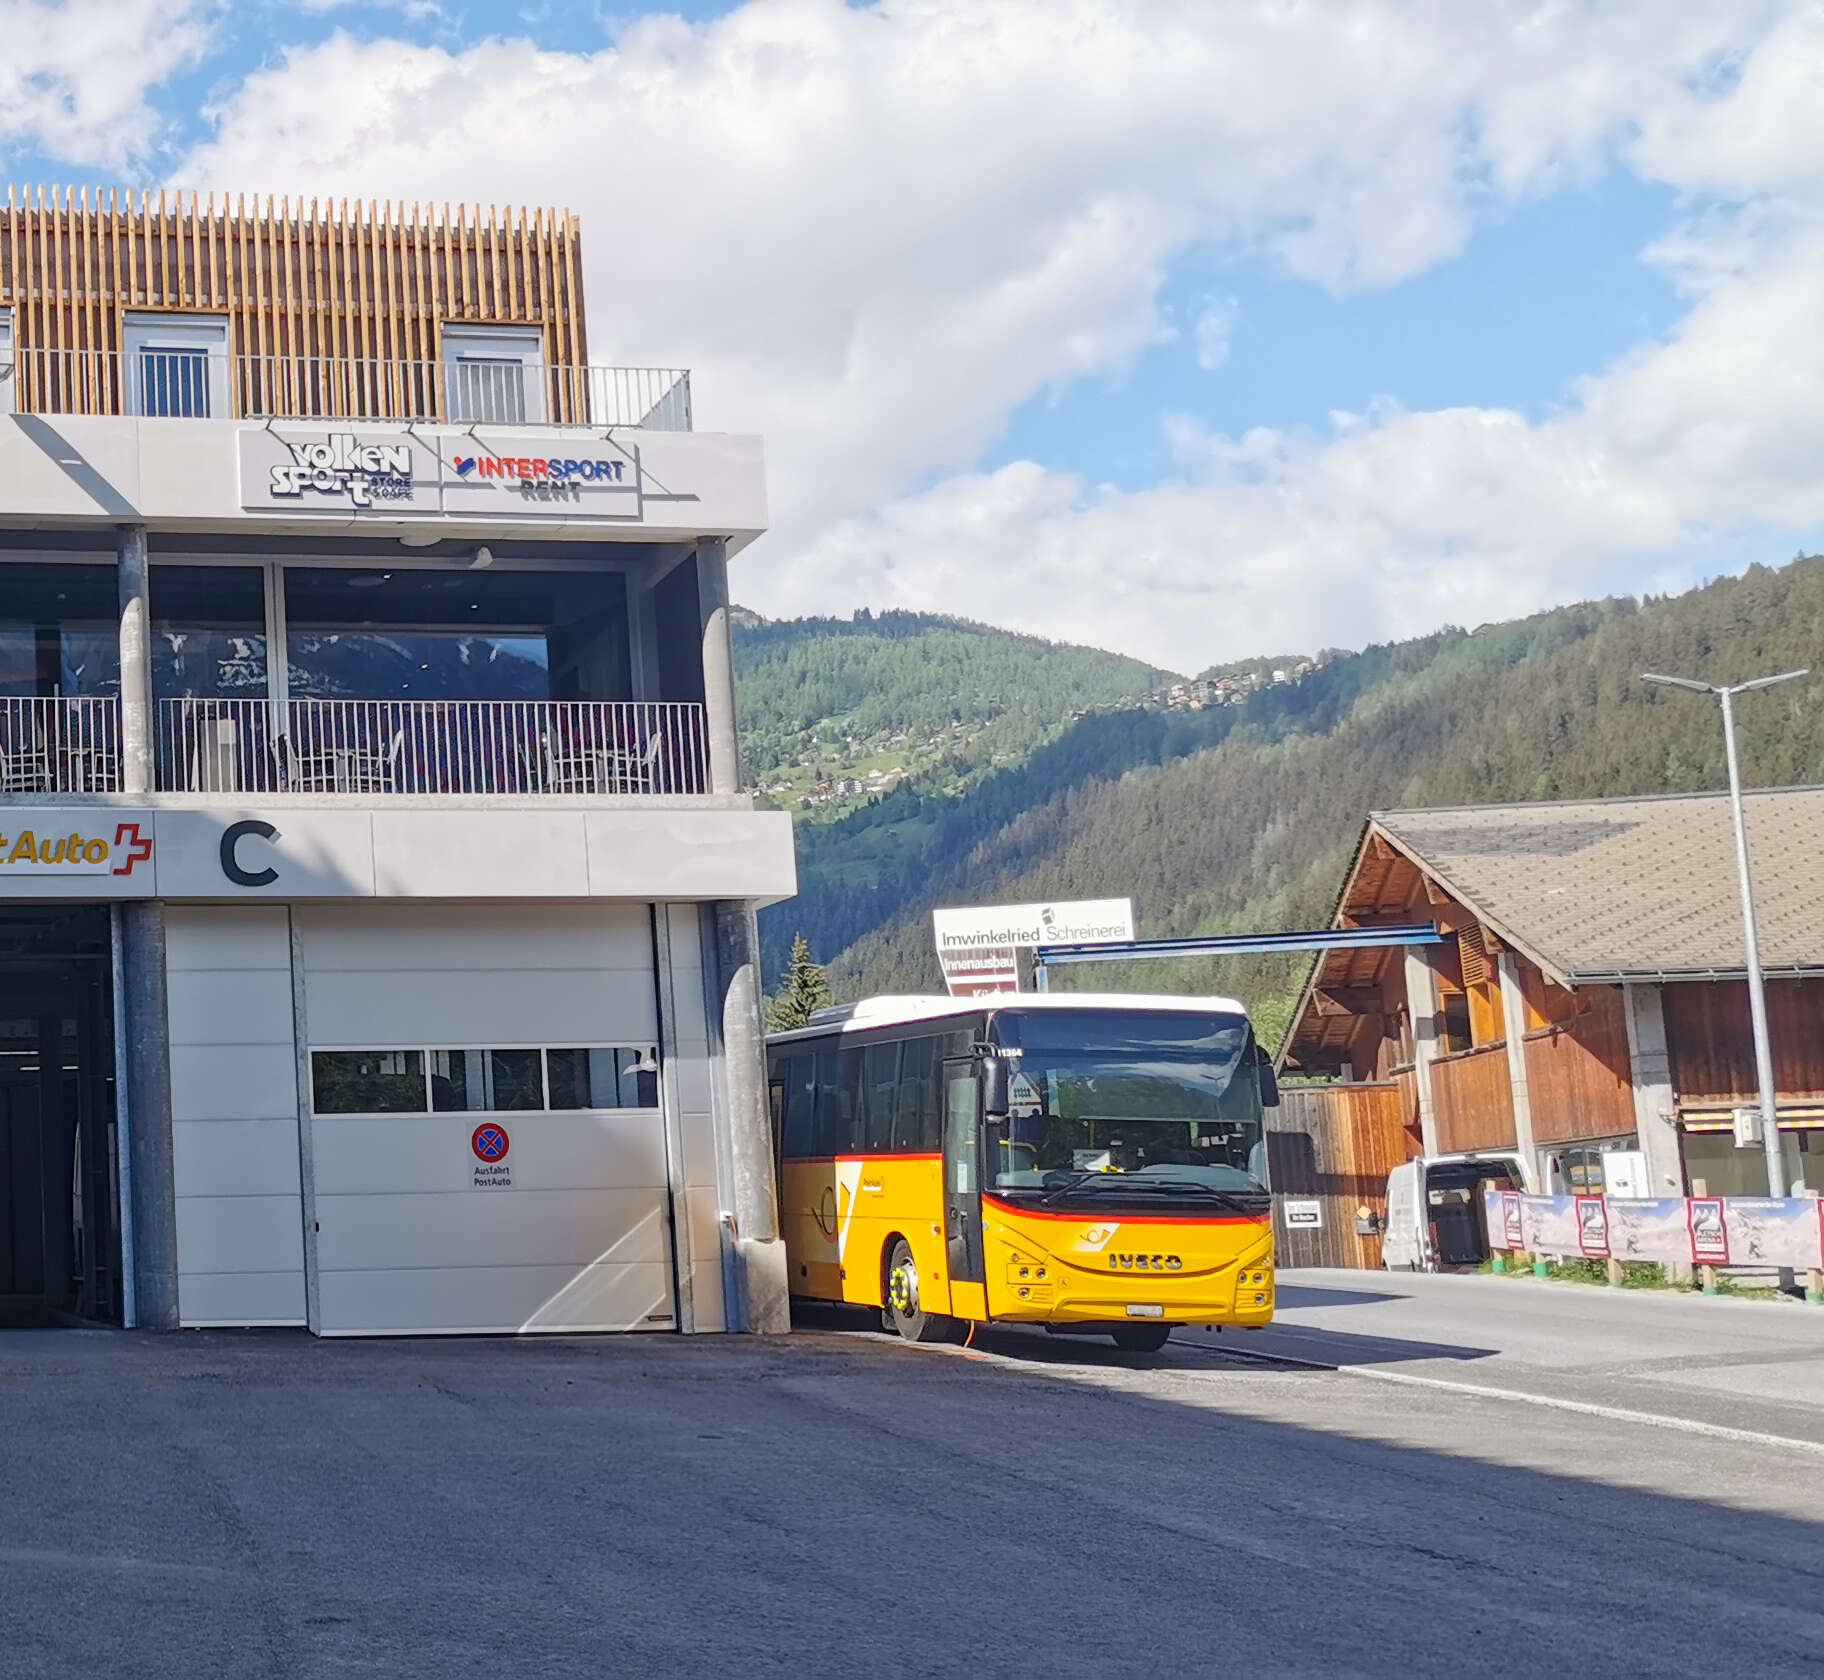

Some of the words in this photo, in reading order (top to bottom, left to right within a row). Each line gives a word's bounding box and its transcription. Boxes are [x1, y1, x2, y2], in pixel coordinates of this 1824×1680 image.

[478, 457, 626, 481] INTERSPORT
[371, 476, 412, 488] STORE
[219, 819, 281, 888] C
[942, 928, 1041, 947] Imwinkelried
[1046, 921, 1127, 942] Schreinerei
[944, 954, 1014, 971] Innenausbau
[474, 1166, 510, 1175] Ausfahrt
[474, 1178, 512, 1187] PostAuto
[1109, 1253, 1183, 1270] IVECO
